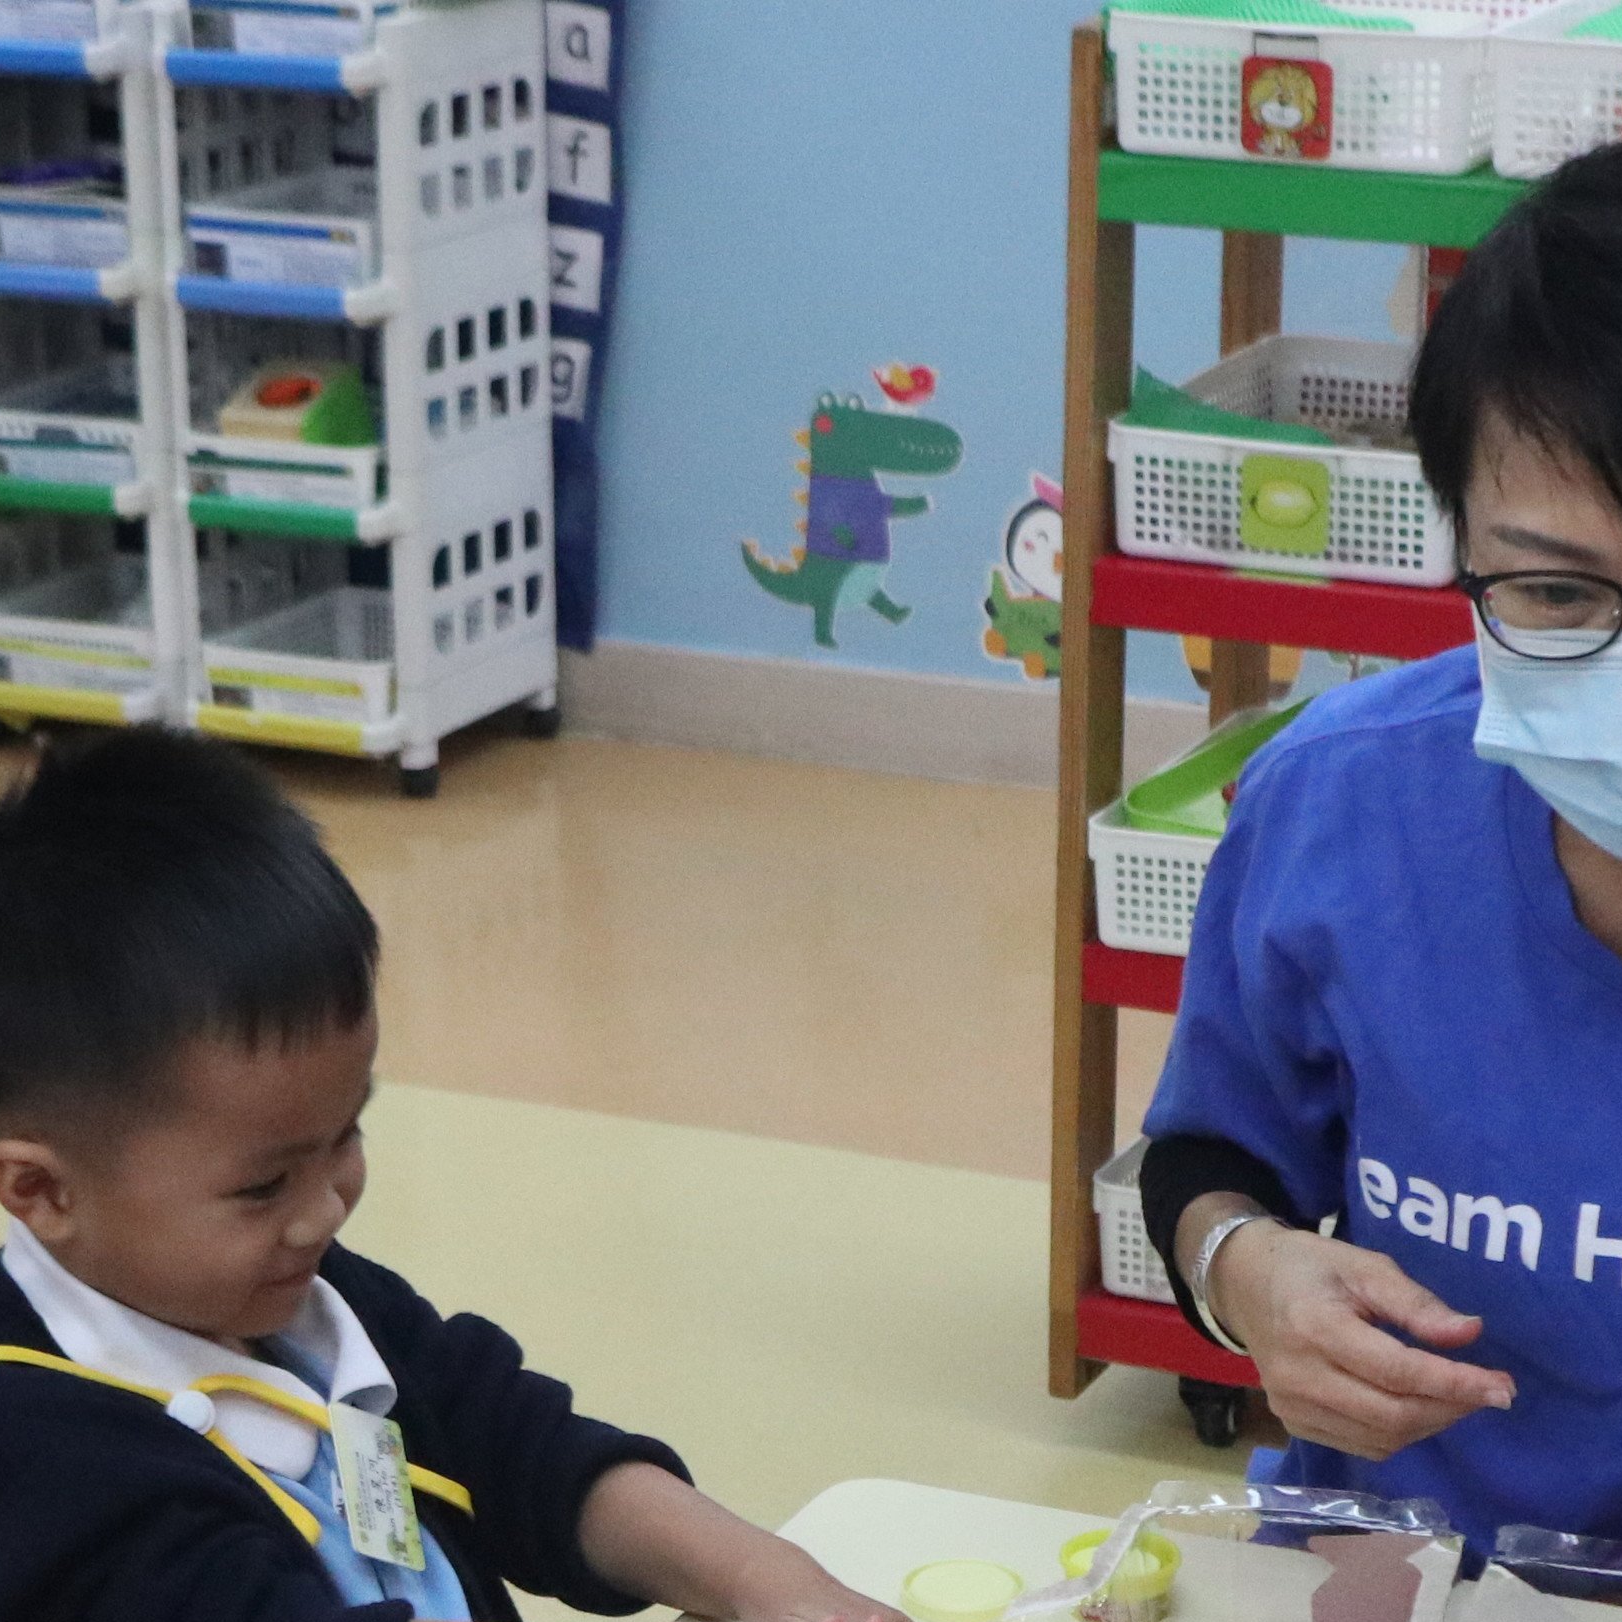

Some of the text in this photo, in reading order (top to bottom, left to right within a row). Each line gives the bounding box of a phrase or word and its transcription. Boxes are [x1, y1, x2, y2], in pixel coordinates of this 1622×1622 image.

[565, 23, 592, 63] a
[564, 128, 591, 185] f
[1357, 1157, 1543, 1271] eam
